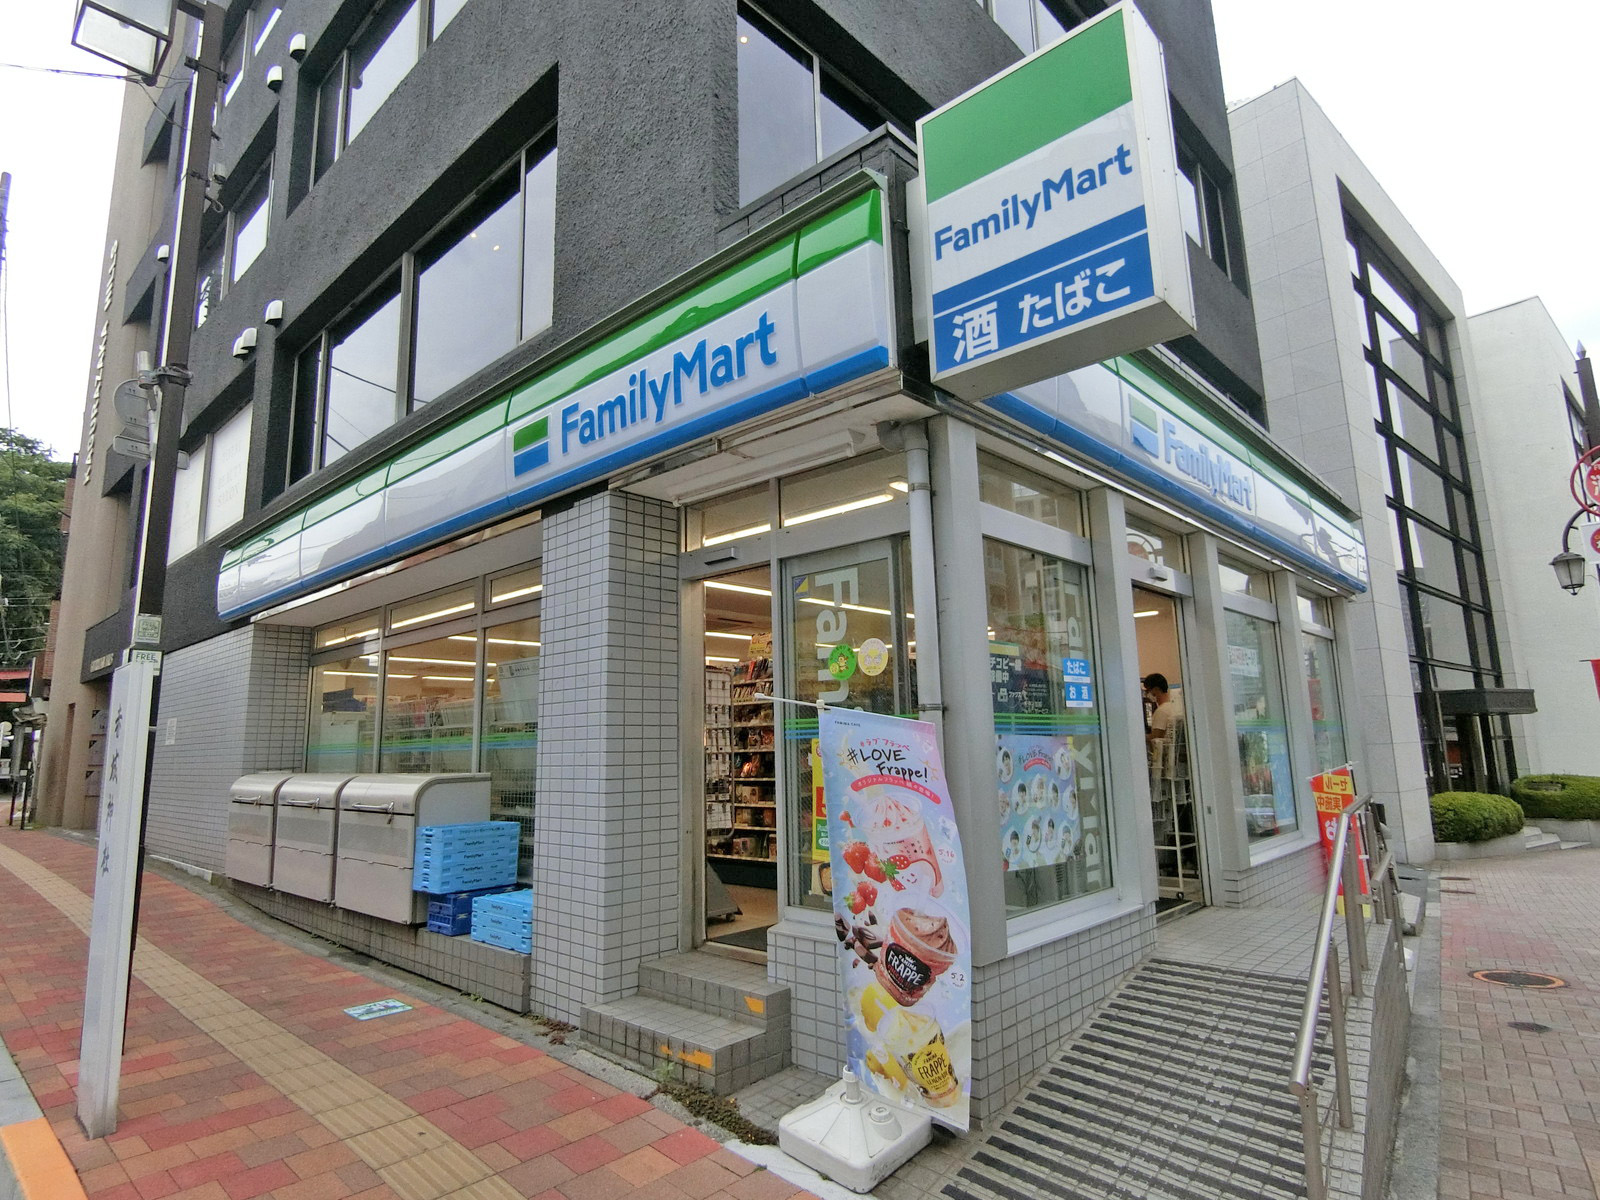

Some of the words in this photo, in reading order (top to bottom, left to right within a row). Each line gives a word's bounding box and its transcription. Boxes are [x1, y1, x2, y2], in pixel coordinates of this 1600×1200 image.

[934, 144, 1133, 261] FamilyMart
[103, 240, 119, 312] HILLS
[952, 301, 999, 363] 酒
[1018, 258, 1131, 335] たばこ
[560, 311, 780, 455] FamilyMart
[1162, 417, 1254, 511] FamilyMart
[136, 653, 156, 661] FREE
[1066, 659, 1086, 675] たばこ
[847, 747, 906, 765] #LOVE
[876, 761, 928, 783] Frappe!
[887, 950, 924, 985] FRAPPE
[950, 972, 965, 982] 5.2
[918, 1053, 948, 1080] FRAPPE
